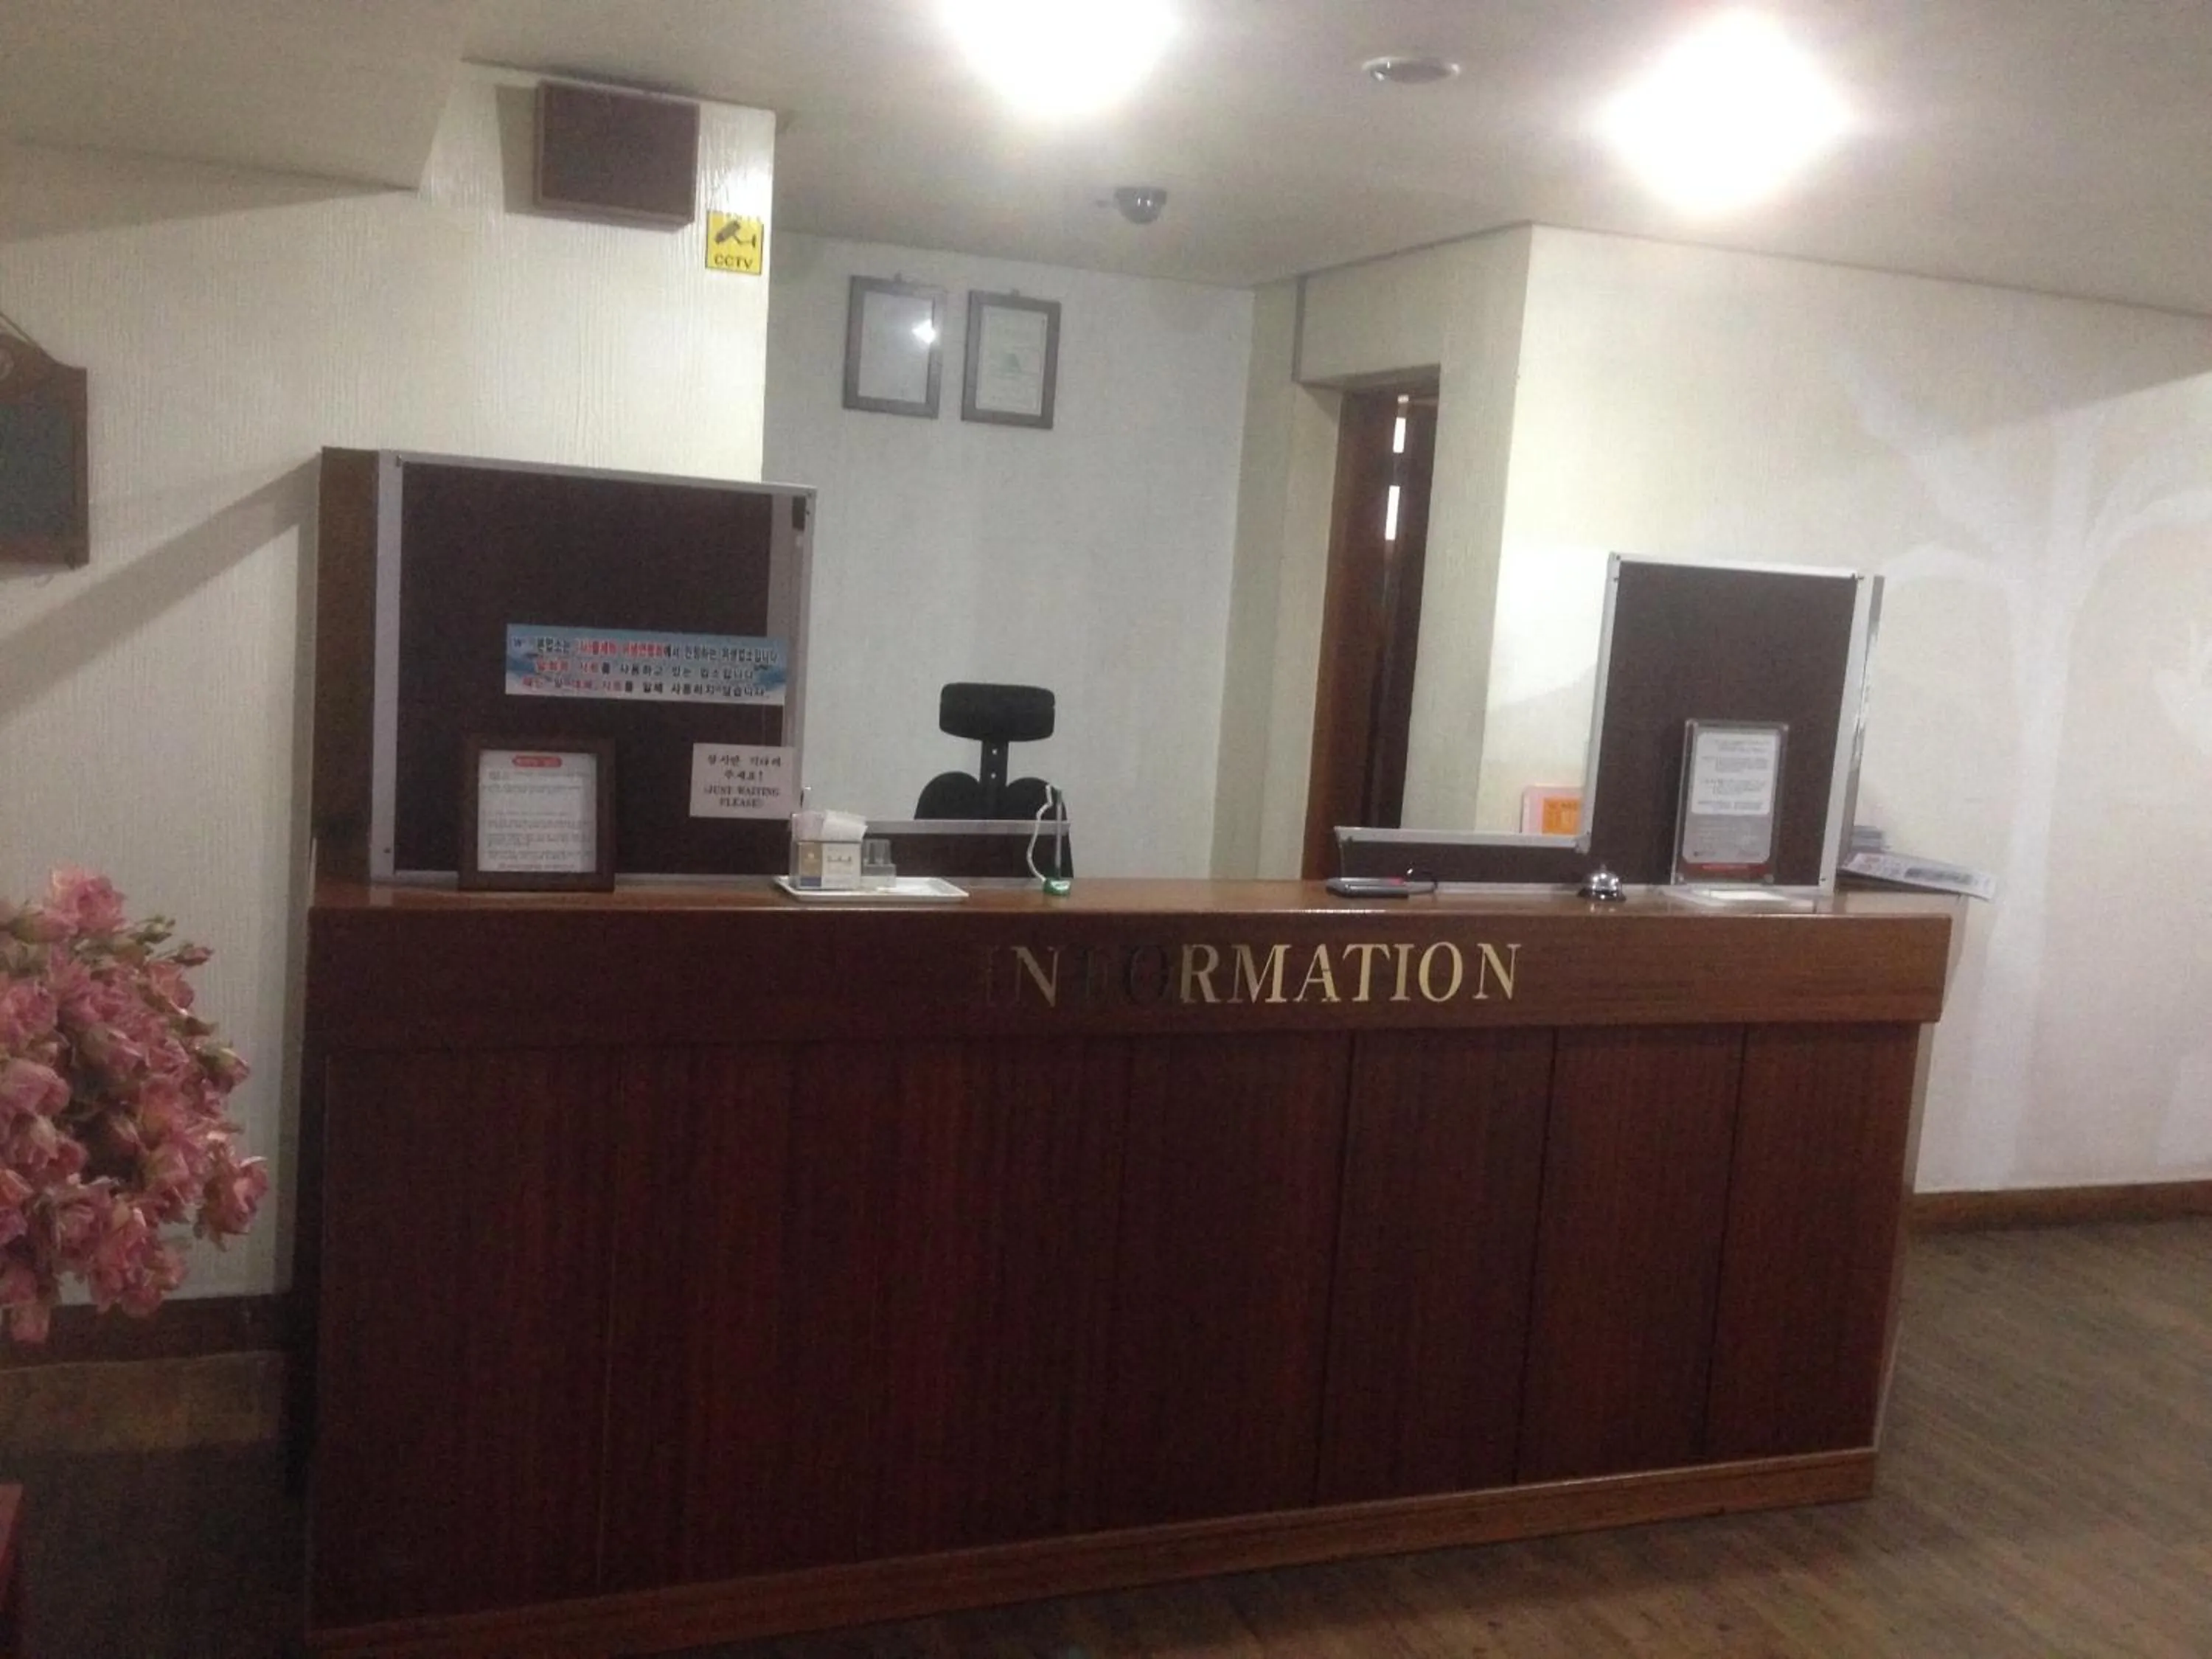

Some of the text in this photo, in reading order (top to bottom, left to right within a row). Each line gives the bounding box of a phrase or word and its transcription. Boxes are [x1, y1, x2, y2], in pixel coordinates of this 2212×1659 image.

[714, 254, 753, 269] CCTV
[620, 663, 664, 677] 사용하고
[672, 666, 692, 678] 있는
[707, 754, 782, 768] 잠시만 기다려
[737, 786, 780, 797] WAITING
